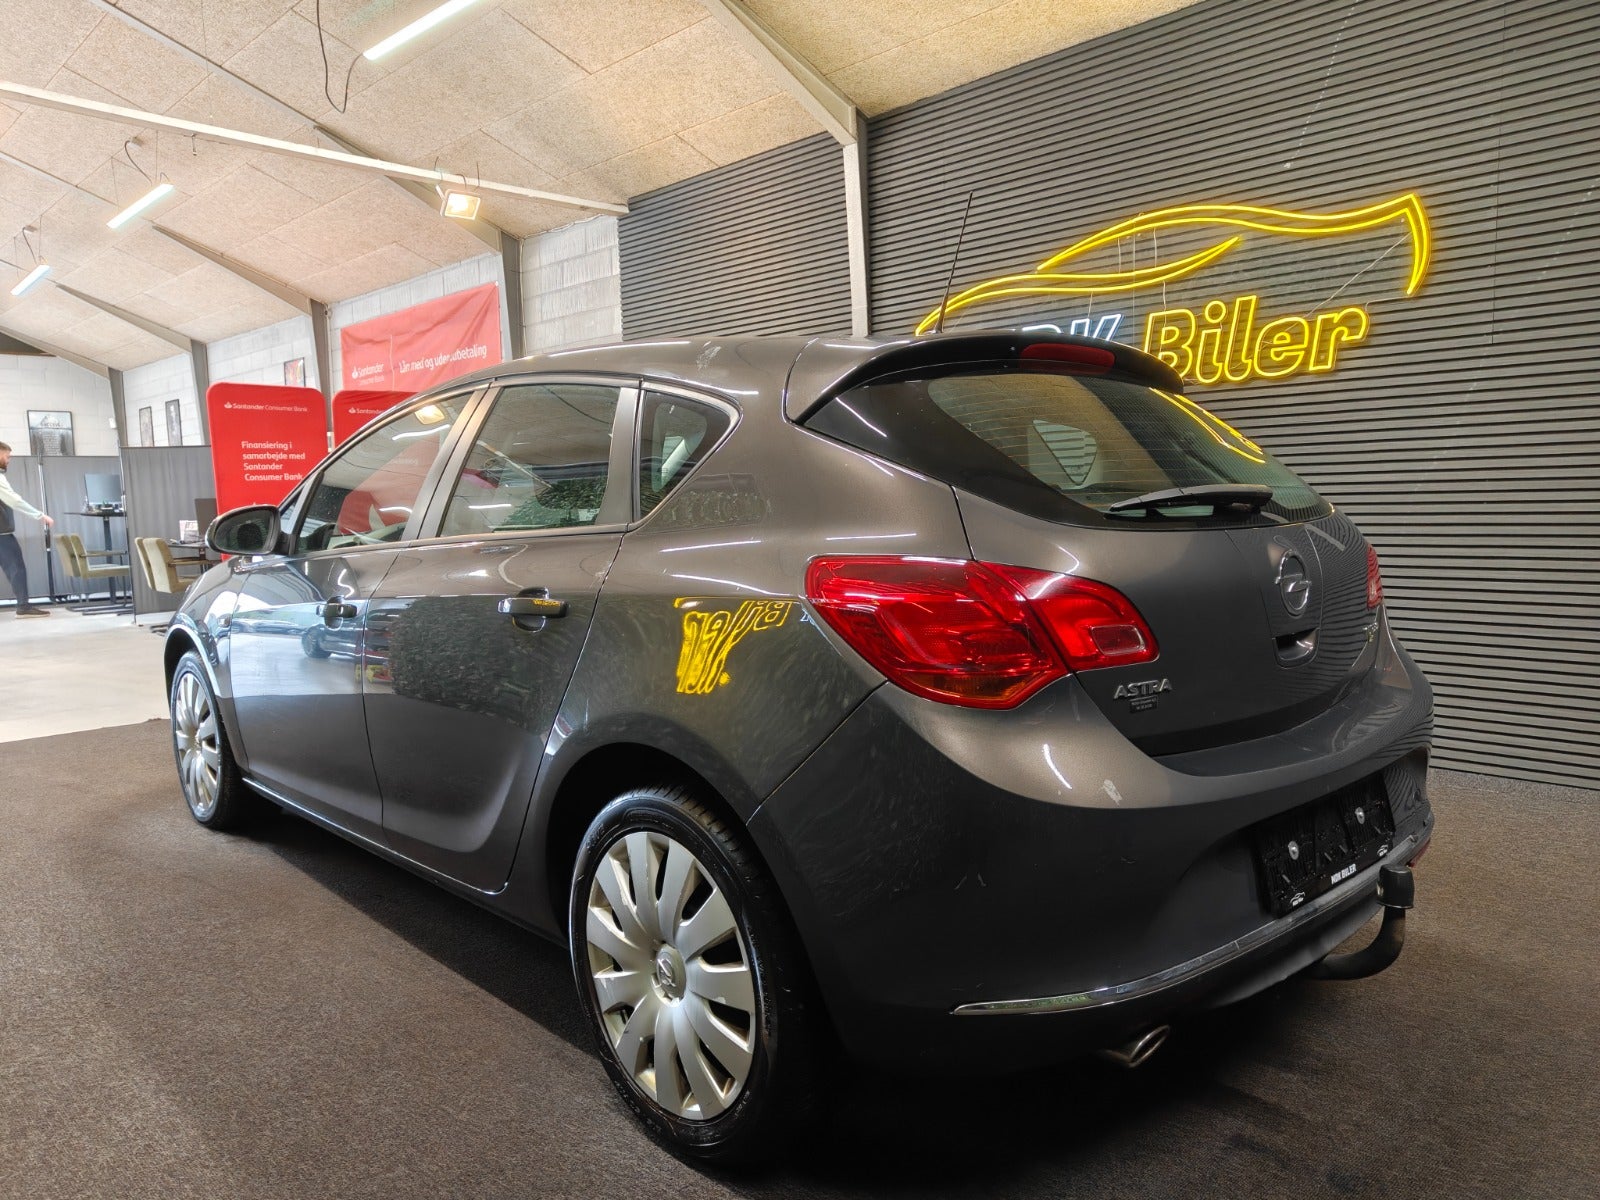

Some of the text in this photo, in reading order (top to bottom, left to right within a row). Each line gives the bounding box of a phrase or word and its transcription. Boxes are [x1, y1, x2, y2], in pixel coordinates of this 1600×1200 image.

[1144, 294, 1370, 384] Biler
[424, 357, 434, 371] og
[241, 441, 288, 451] Finansiering
[242, 452, 306, 461] samarbejde med
[243, 462, 283, 471] Santander
[244, 473, 303, 481] Consumer Bank
[1114, 678, 1172, 699] ASTRA
